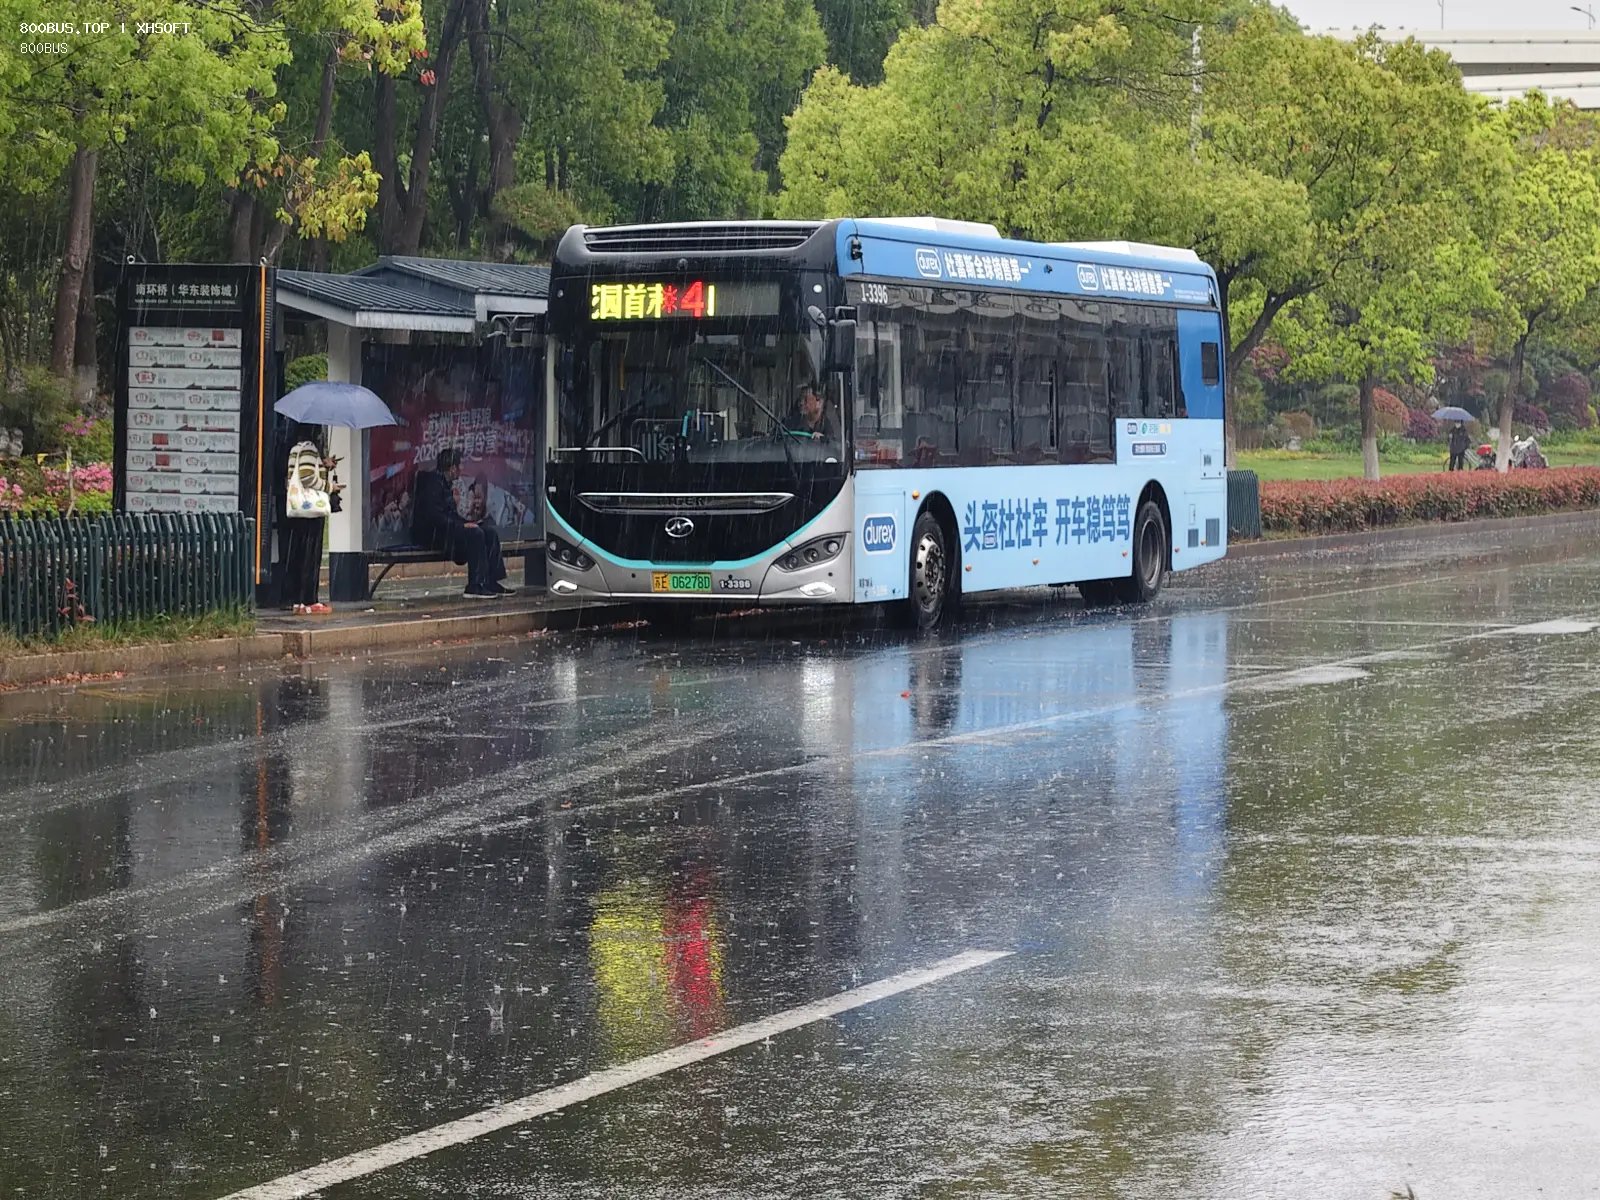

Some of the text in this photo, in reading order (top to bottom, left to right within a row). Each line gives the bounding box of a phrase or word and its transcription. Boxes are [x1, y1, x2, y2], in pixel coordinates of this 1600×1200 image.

[918, 255, 939, 272] durex
[860, 282, 889, 304] 1-3396
[864, 519, 895, 546] durex
[964, 493, 1131, 553] 头盔杜杜牢 开车稳笃笃
